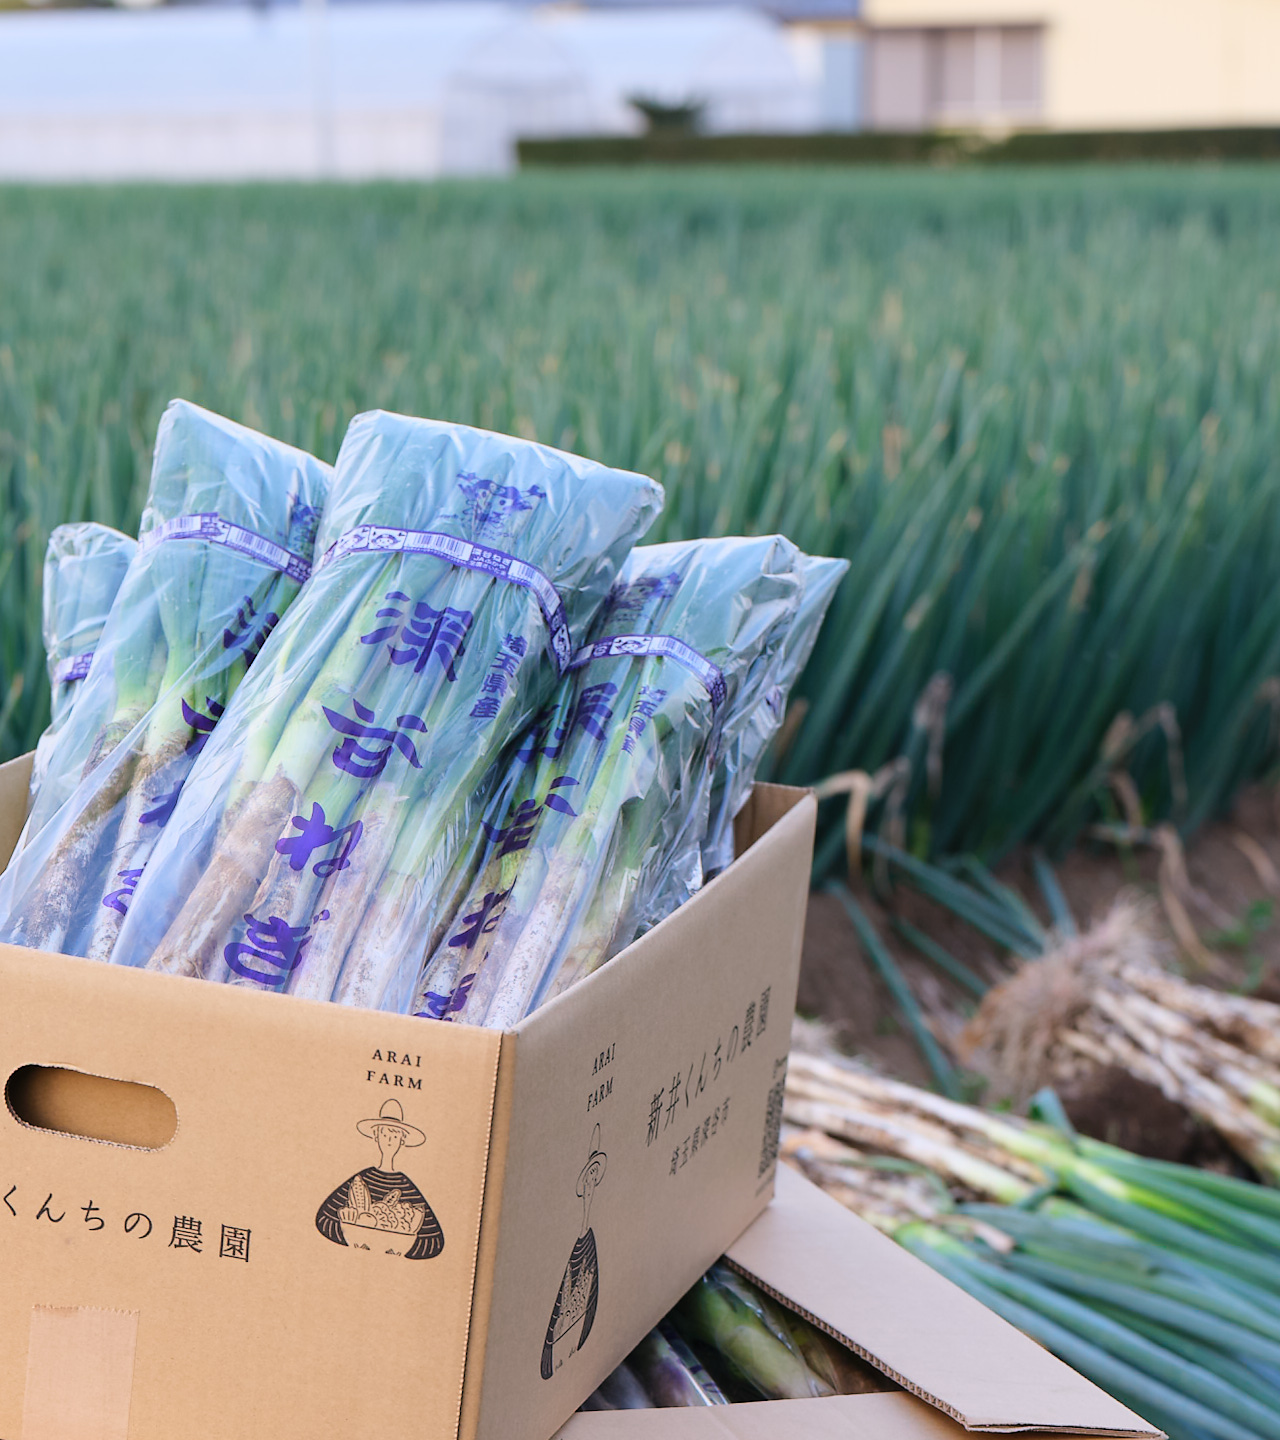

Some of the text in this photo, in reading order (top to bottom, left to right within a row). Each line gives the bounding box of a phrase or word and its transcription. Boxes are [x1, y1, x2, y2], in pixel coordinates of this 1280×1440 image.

[469, 631, 527, 720] 埼玉県産
[223, 591, 474, 988] 深谷ねぎ
[371, 1048, 423, 1069] ARAI
[592, 1043, 616, 1077] ARAI
[366, 1070, 423, 1091] FARM
[586, 1077, 614, 1112] FARM
